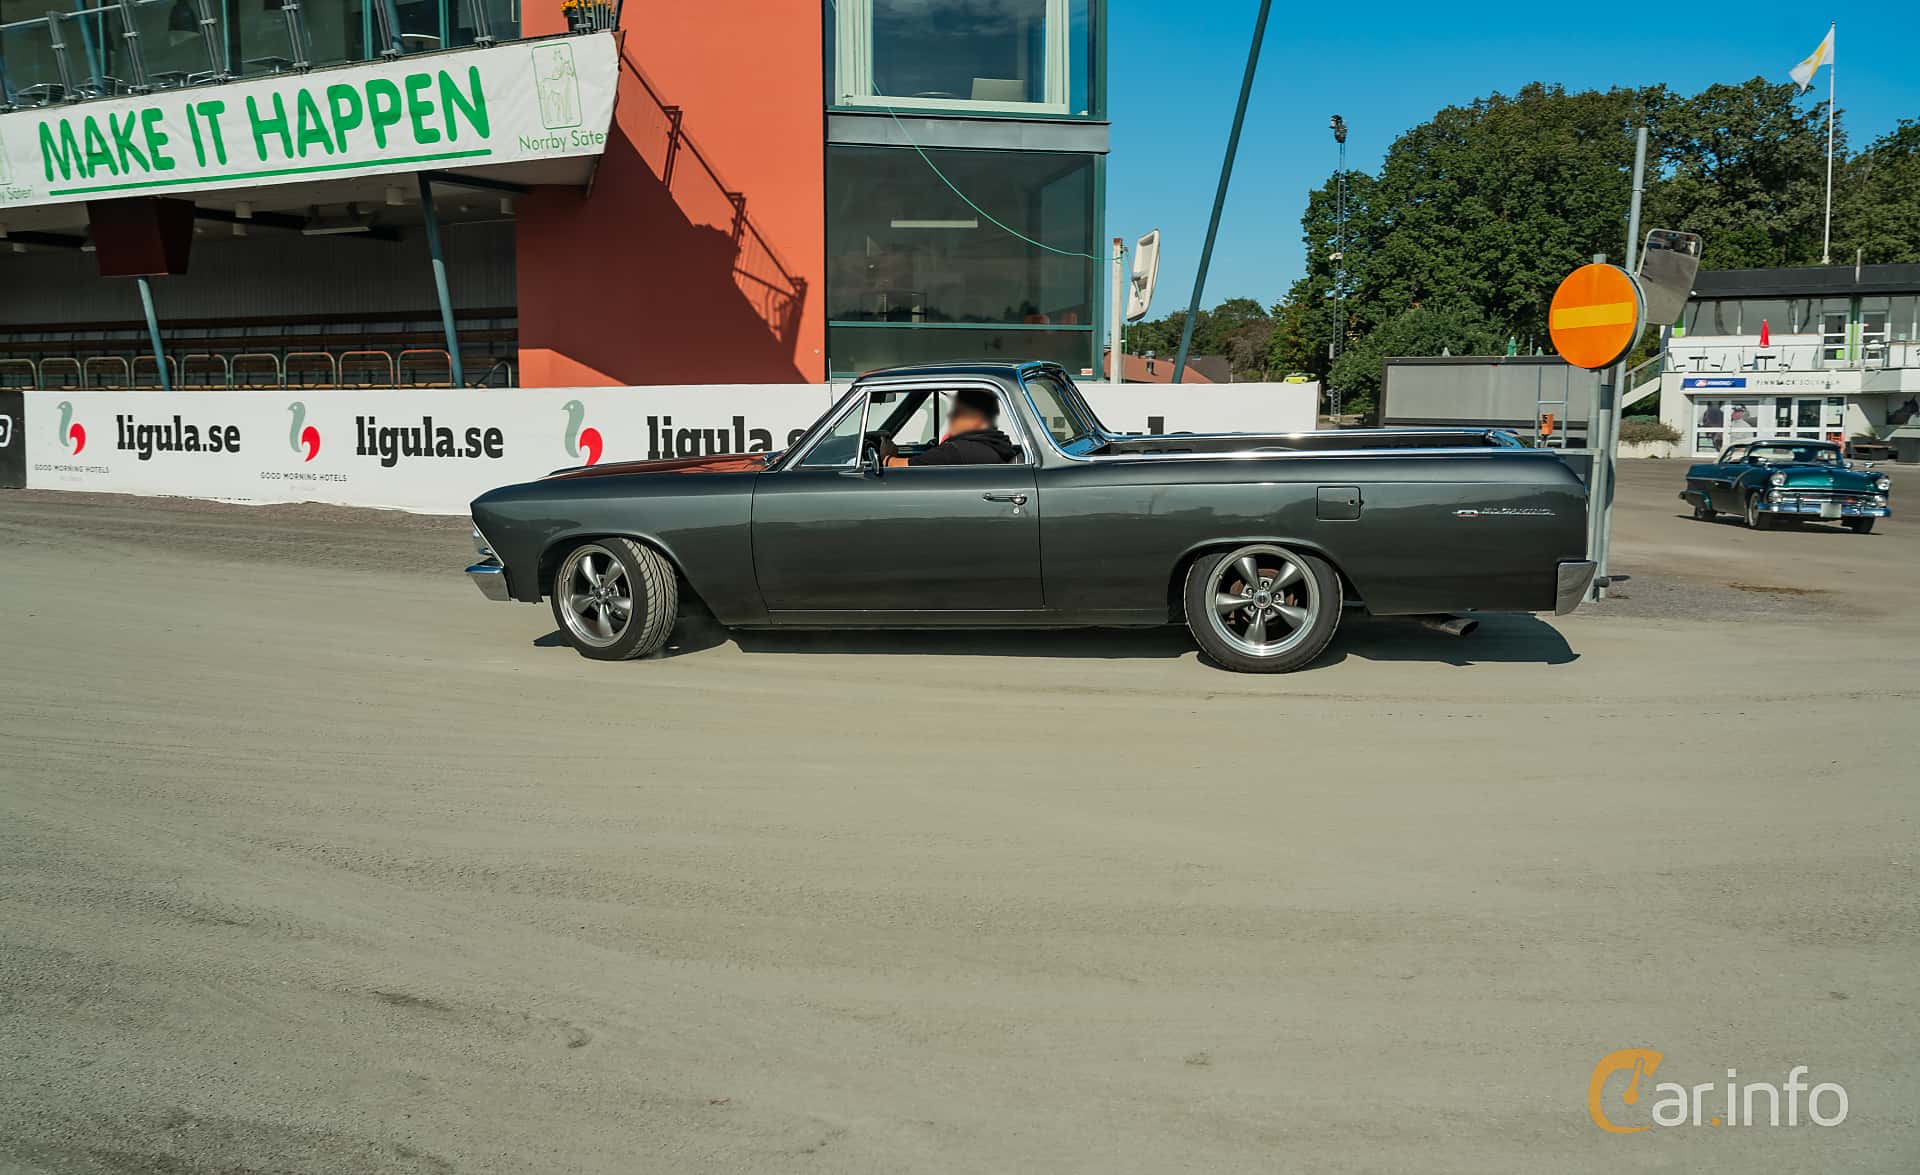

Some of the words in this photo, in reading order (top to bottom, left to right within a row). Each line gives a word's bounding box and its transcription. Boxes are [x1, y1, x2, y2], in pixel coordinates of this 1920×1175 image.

[39, 107, 176, 182] MAKE
[186, 100, 226, 168] IT
[246, 65, 490, 161] HAPPEN
[519, 131, 567, 152] Norrby
[116, 415, 241, 461] ligula.se
[355, 416, 504, 468] ligula.se
[260, 471, 281, 480] GOOD
[283, 473, 317, 481] MORNING
[319, 474, 347, 482] HOTELS
